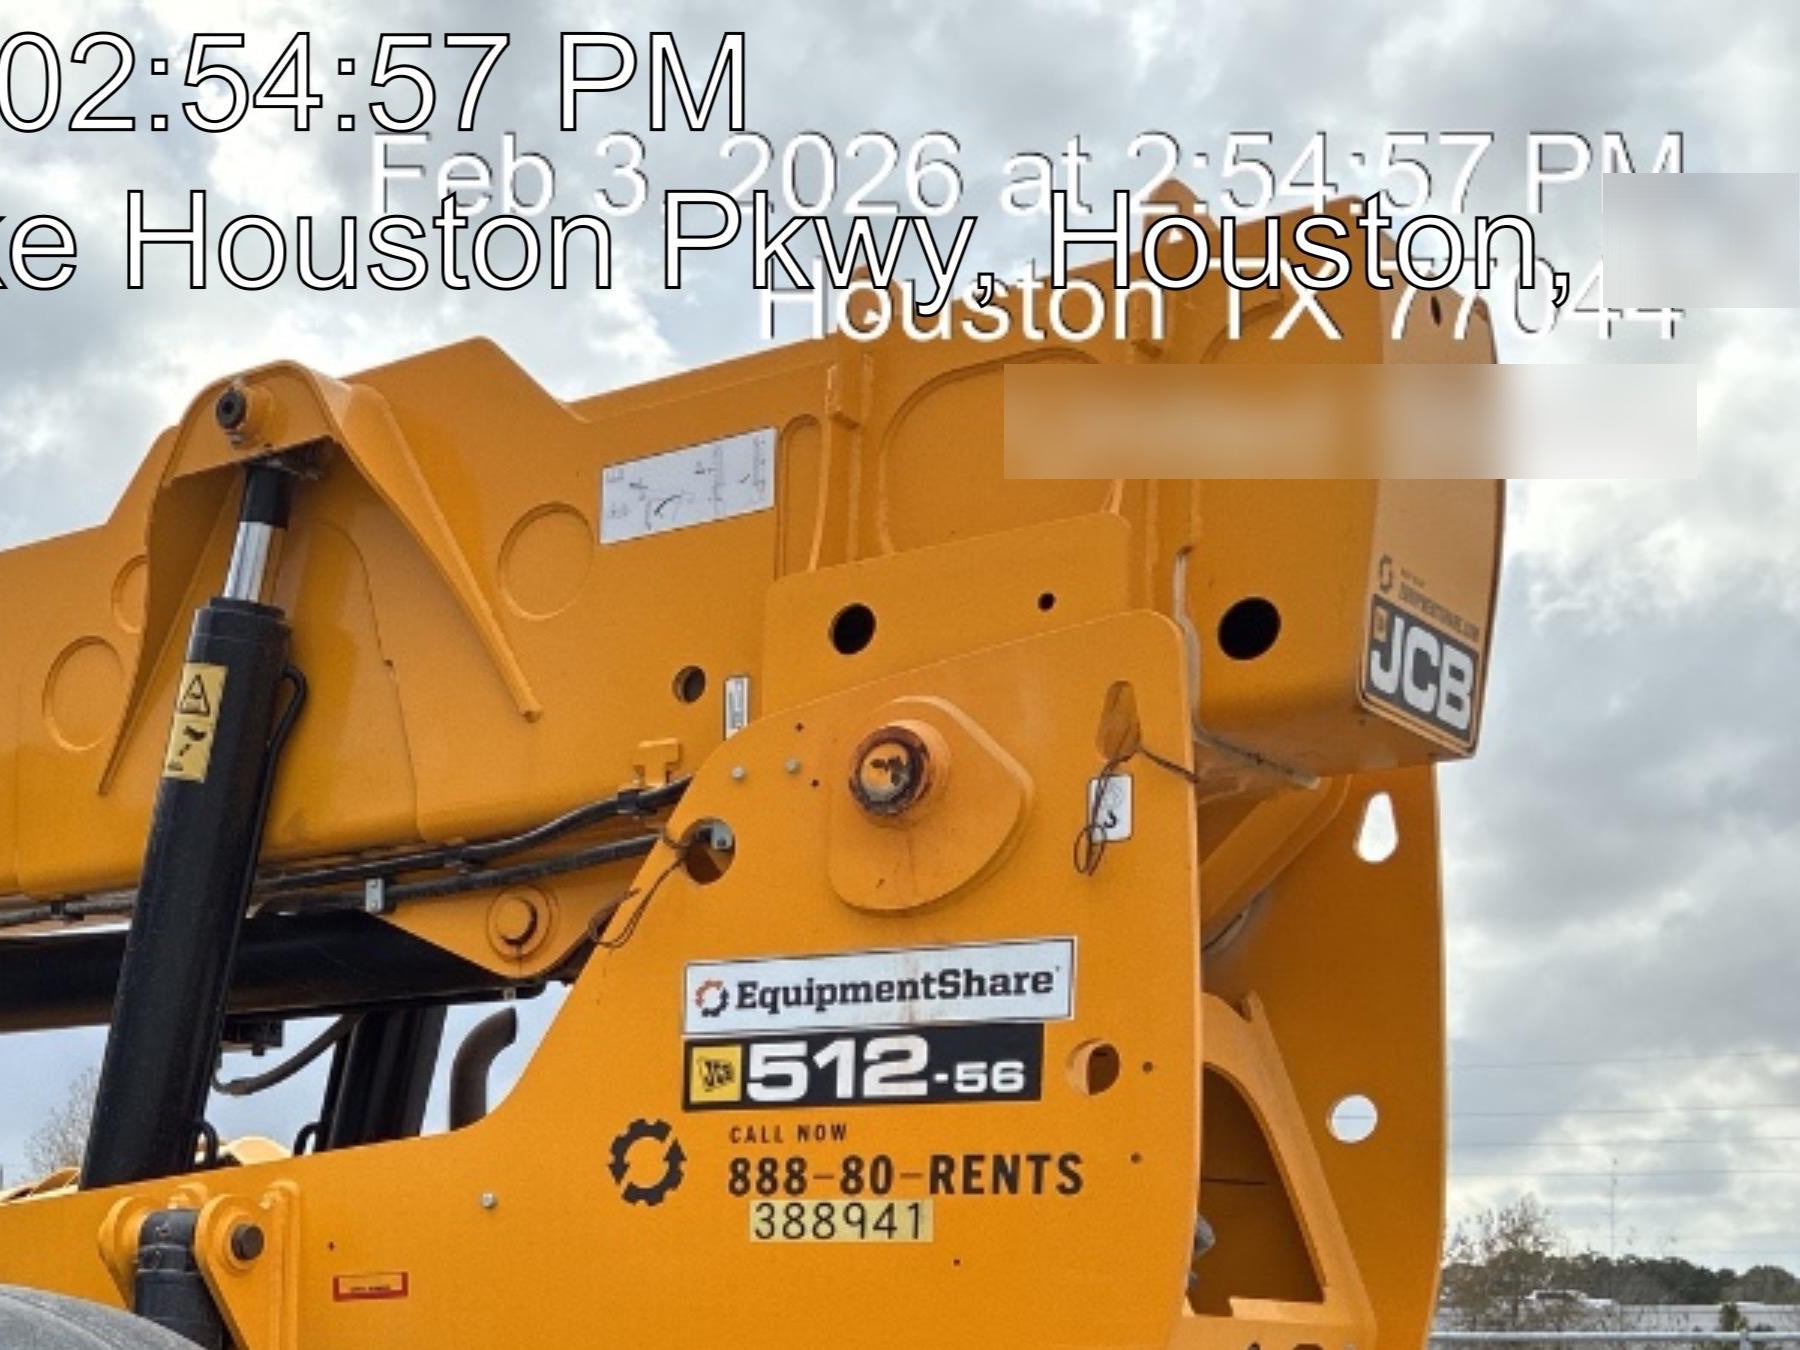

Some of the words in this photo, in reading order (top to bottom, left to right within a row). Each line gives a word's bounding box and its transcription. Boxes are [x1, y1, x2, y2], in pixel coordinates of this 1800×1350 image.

[1369, 616, 1475, 731] JCB
[736, 968, 1055, 1015] EquipmentShare
[747, 1034, 1026, 1102] 512-56
[729, 1126, 784, 1144] CALL
[798, 1123, 848, 1142] NOW
[728, 1152, 1085, 1197] 888-80-RENTS
[754, 1201, 926, 1241] 388941
